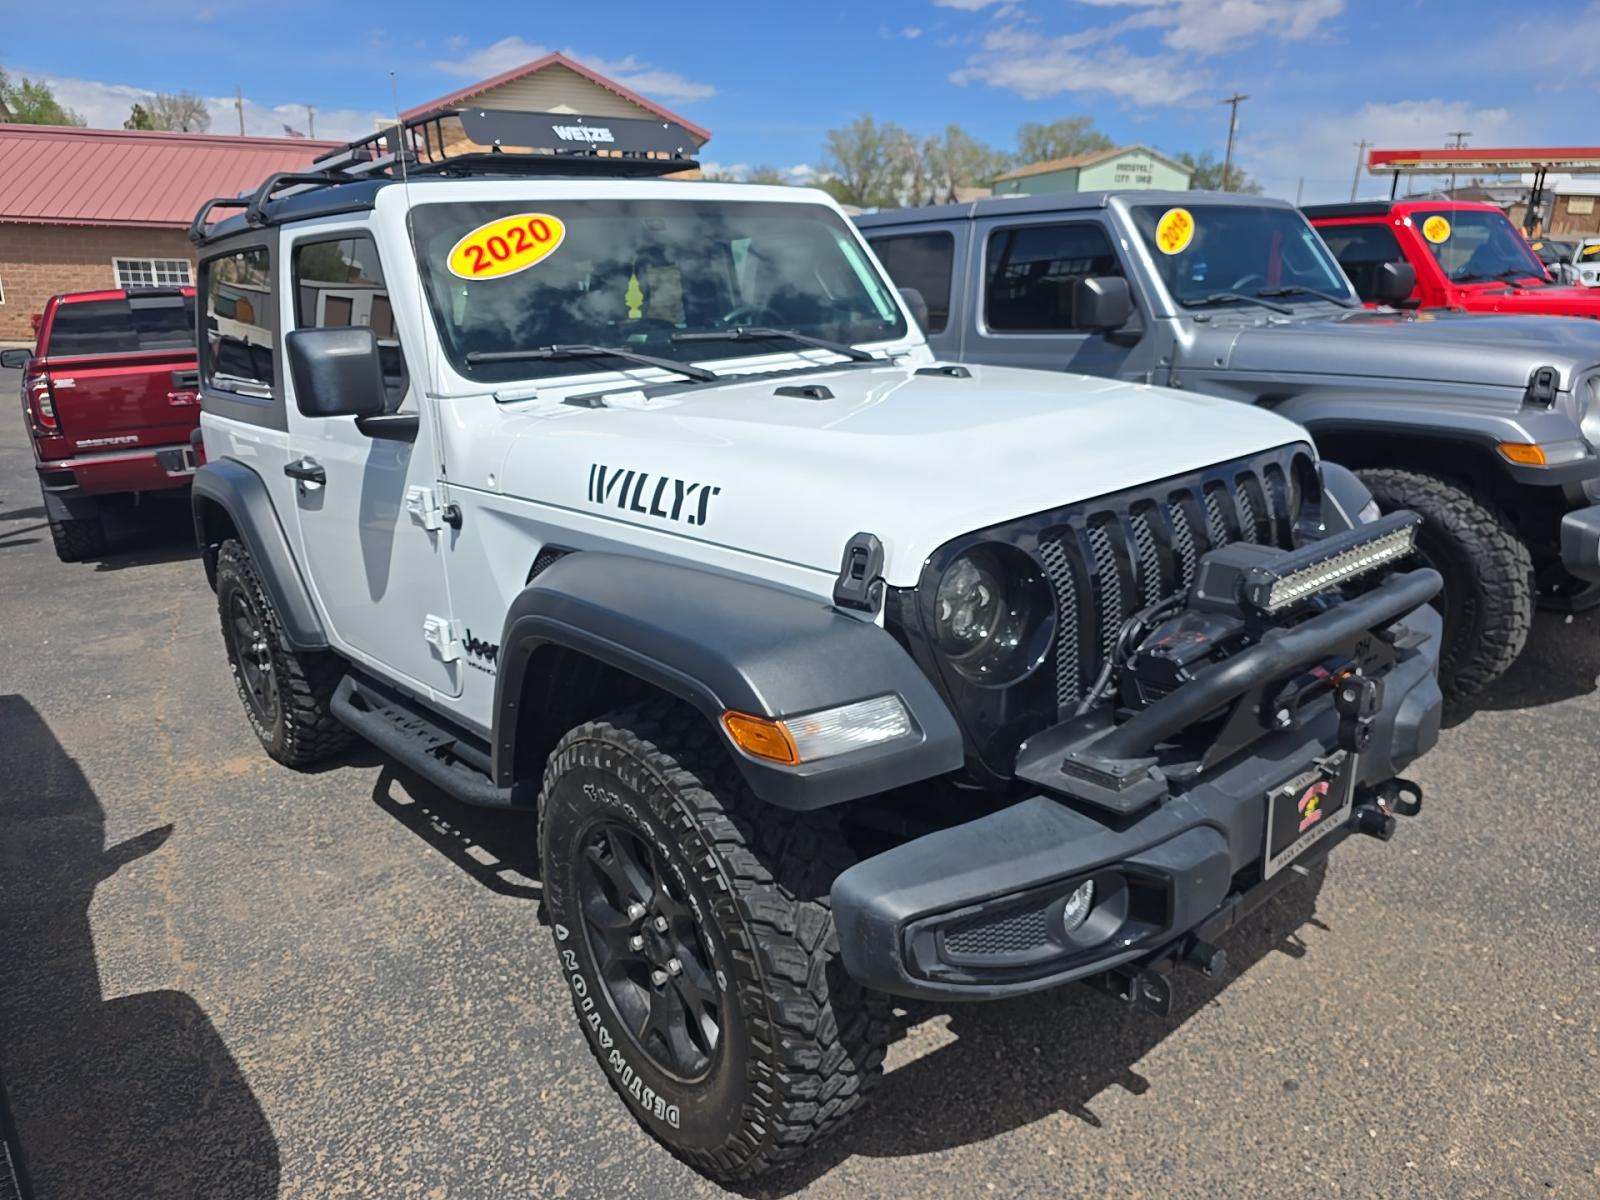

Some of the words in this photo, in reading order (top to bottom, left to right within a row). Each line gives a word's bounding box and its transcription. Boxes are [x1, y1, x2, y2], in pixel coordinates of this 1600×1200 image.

[463, 218, 552, 274] 2020
[588, 463, 722, 527] WILLYS
[462, 628, 499, 668] Jeep
[562, 949, 681, 1130] DESTINATION
